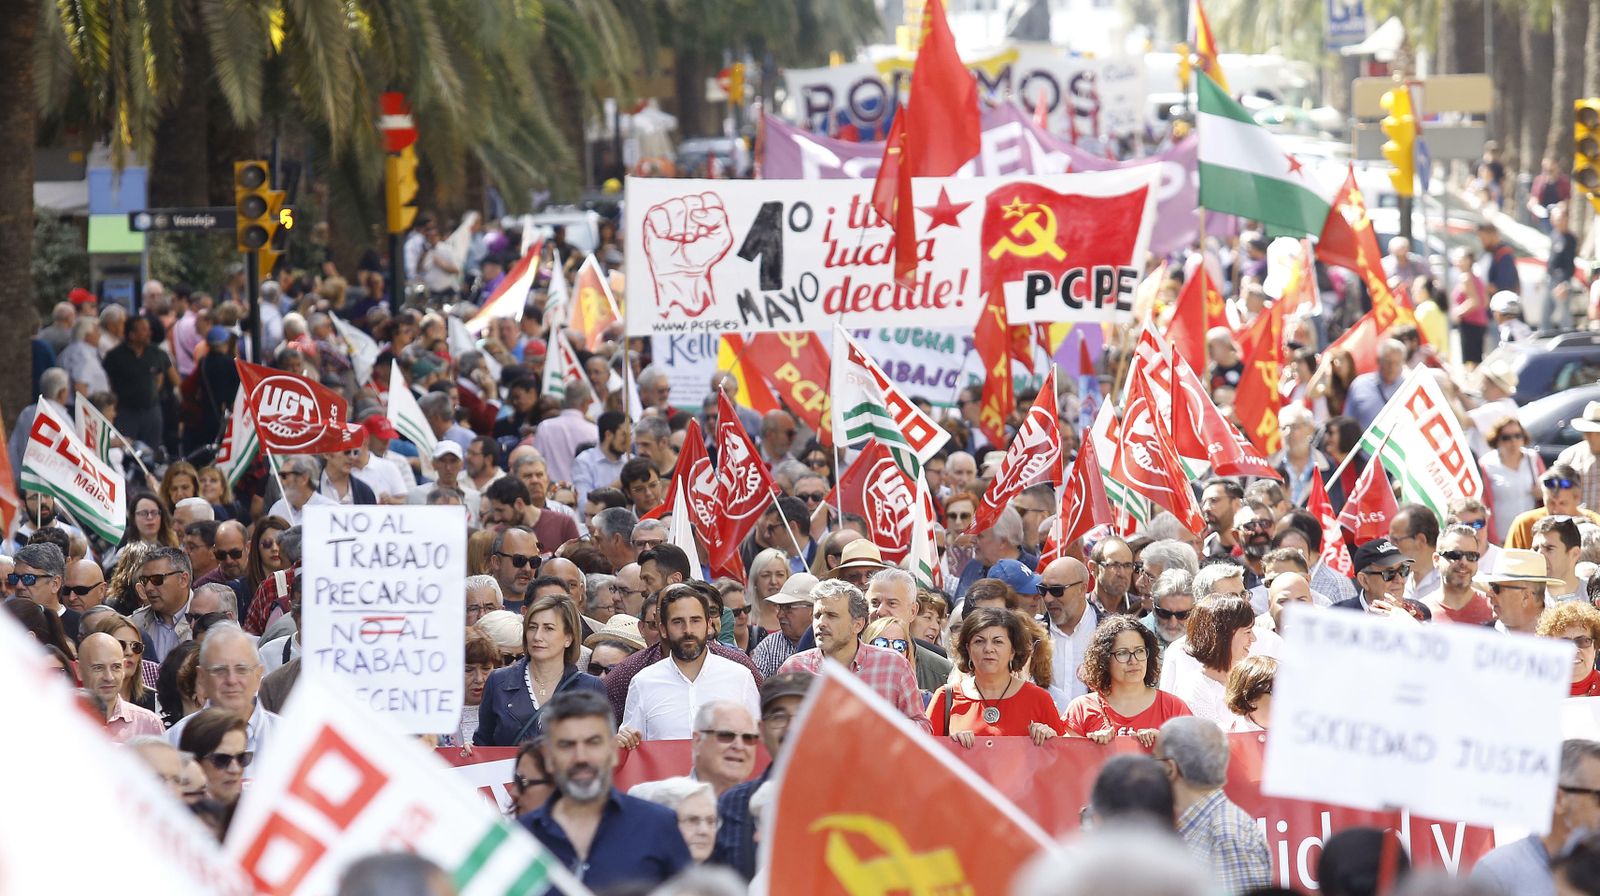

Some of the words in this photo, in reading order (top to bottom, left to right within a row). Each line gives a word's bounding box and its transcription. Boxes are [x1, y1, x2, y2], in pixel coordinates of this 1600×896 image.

[803, 63, 1100, 132] POMOS
[737, 272, 819, 328] MAYO
[1025, 266, 1138, 312] PCPE
[868, 355, 961, 389] ABAJO
[259, 384, 315, 423] UGT
[330, 512, 370, 533] NO
[379, 513, 413, 534] AL
[328, 538, 449, 569] TRABAJO
[397, 617, 438, 643] AL
[315, 648, 446, 675] TRABAJO
[357, 688, 453, 715] CENTE
